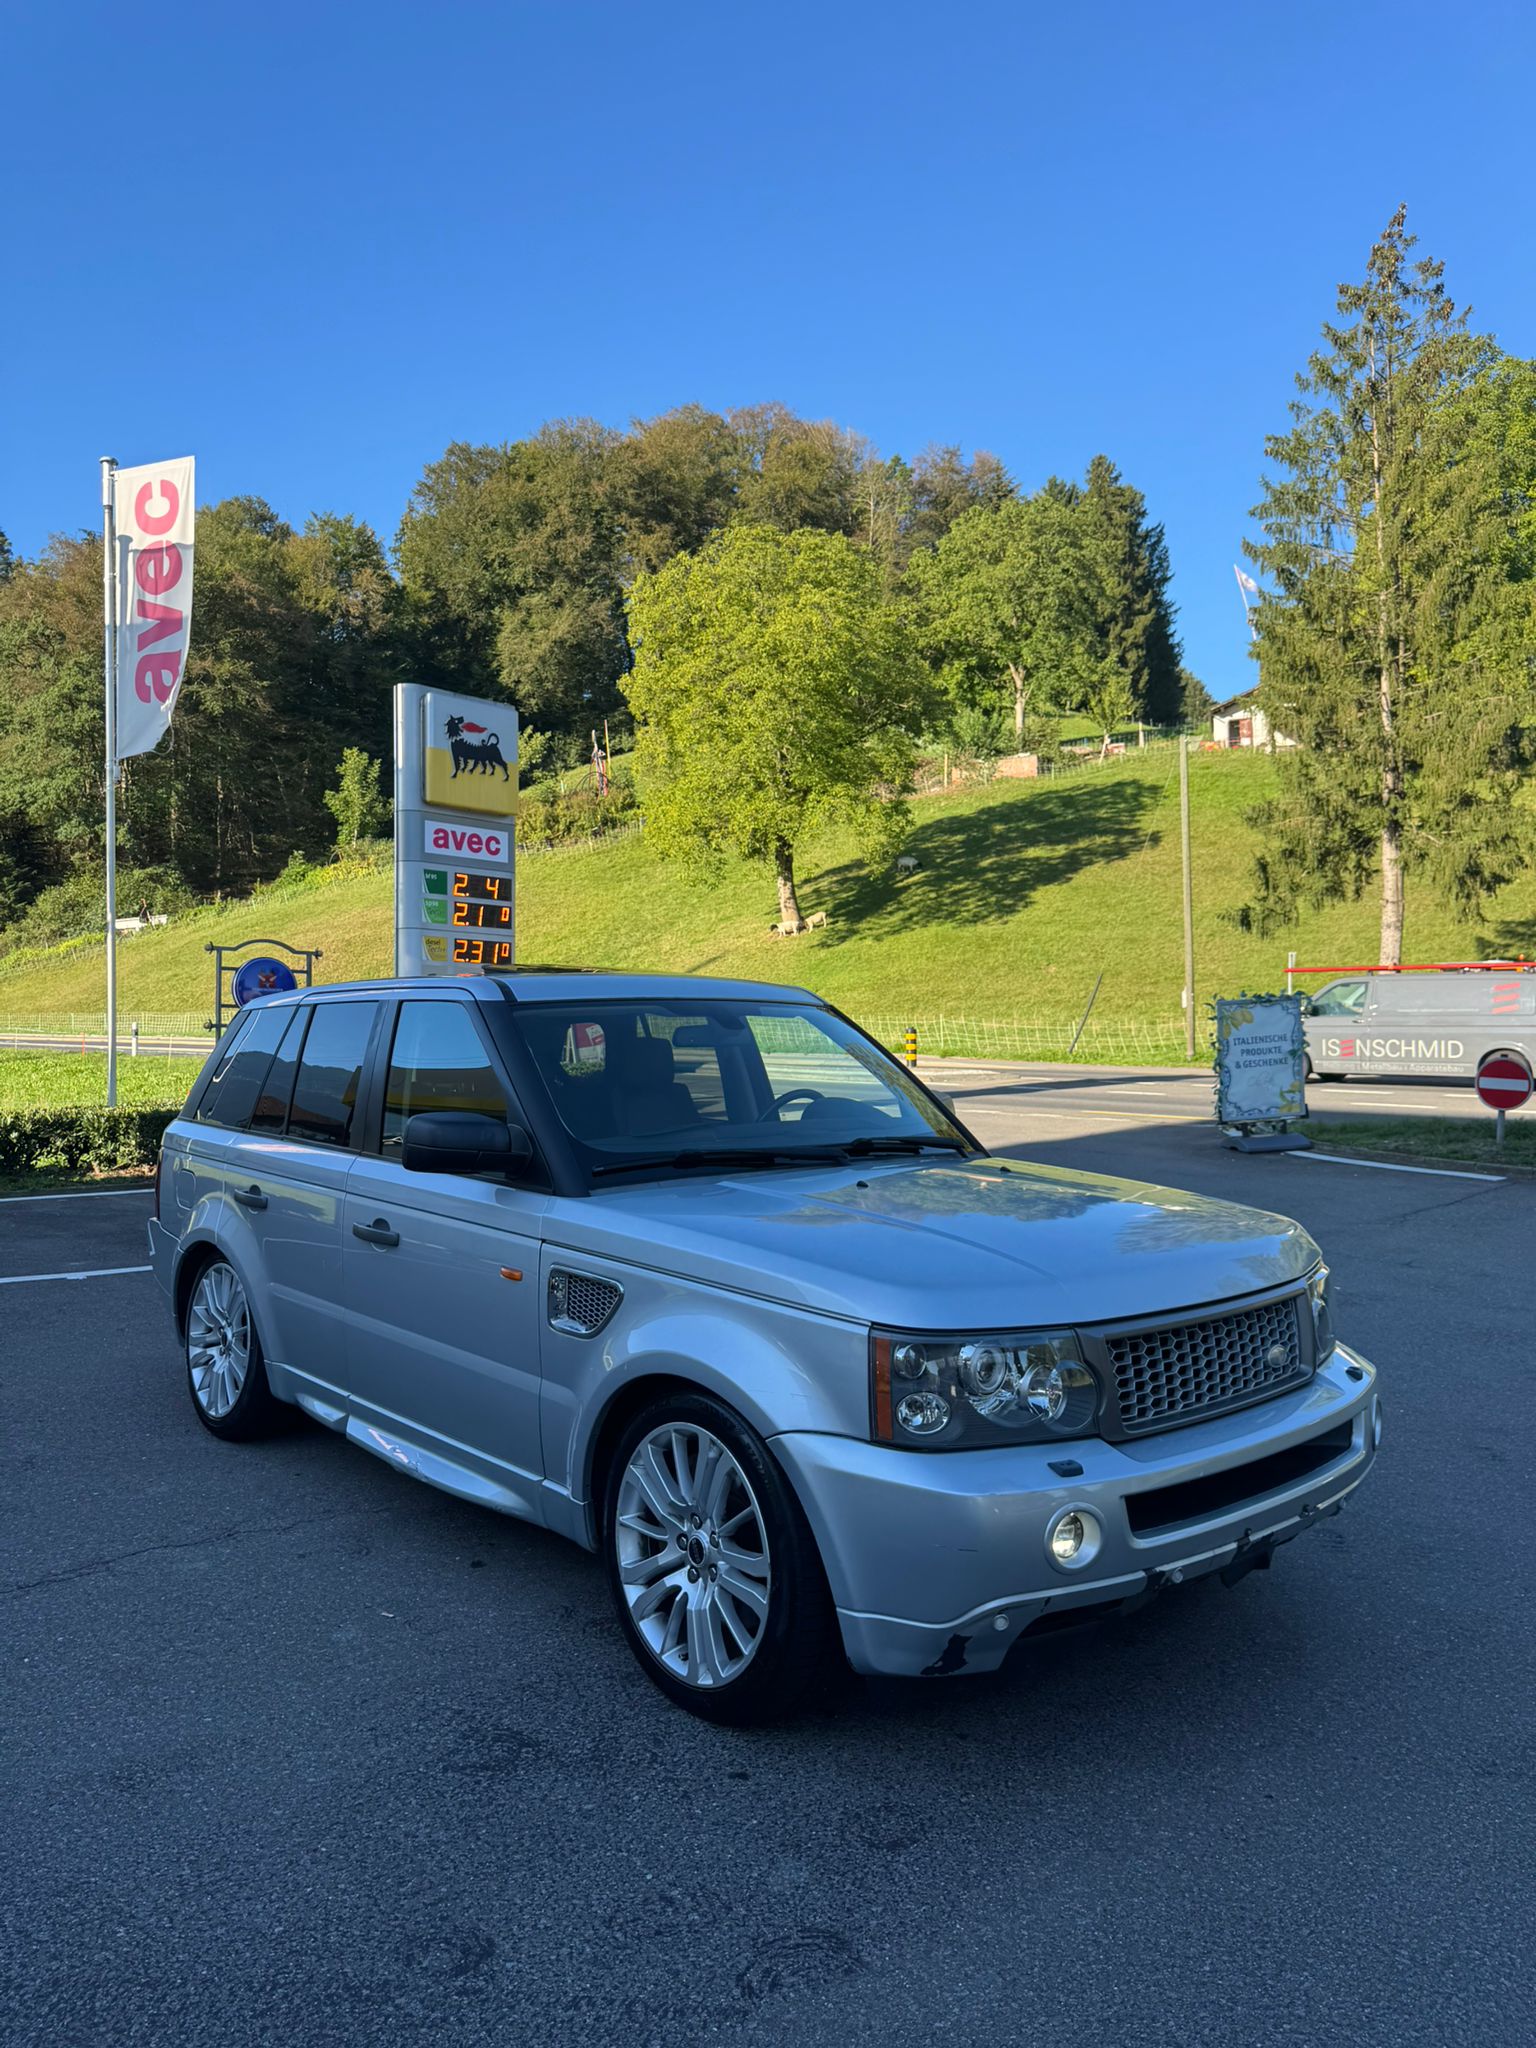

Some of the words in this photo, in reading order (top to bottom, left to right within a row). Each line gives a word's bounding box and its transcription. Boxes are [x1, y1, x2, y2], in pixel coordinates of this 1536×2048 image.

[134, 479, 183, 704] avec
[433, 827, 501, 857] avec
[1233, 1034, 1288, 1046] ITALIENISCHE
[1322, 1038, 1464, 1059] ISENSCHMID
[1240, 1046, 1283, 1057] PRODUKTE
[1243, 1056, 1289, 1069] GESCHENKE
